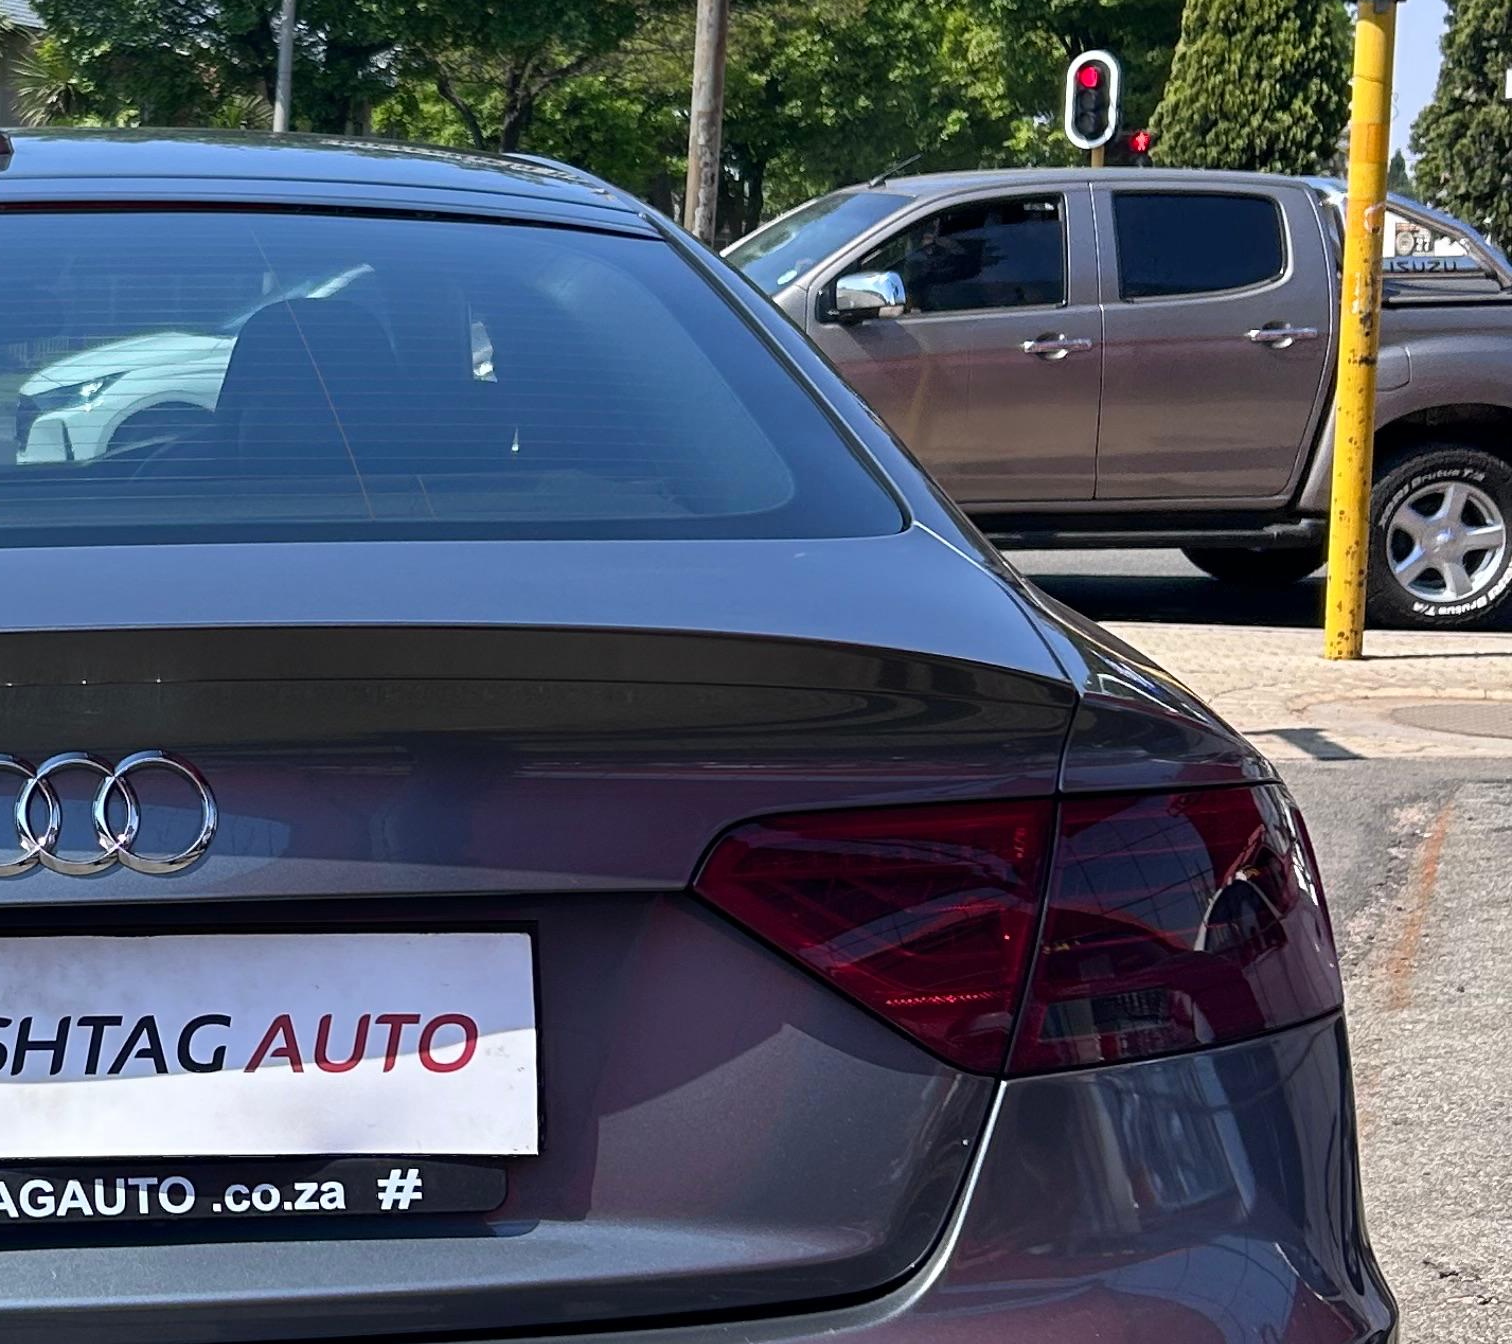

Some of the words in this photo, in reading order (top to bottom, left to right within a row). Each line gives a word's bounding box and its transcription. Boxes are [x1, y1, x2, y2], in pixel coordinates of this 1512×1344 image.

[1390, 259, 1457, 273] ISUZU
[243, 1013, 478, 1073] AUTO
[212, 1180, 346, 1212] .co.za
